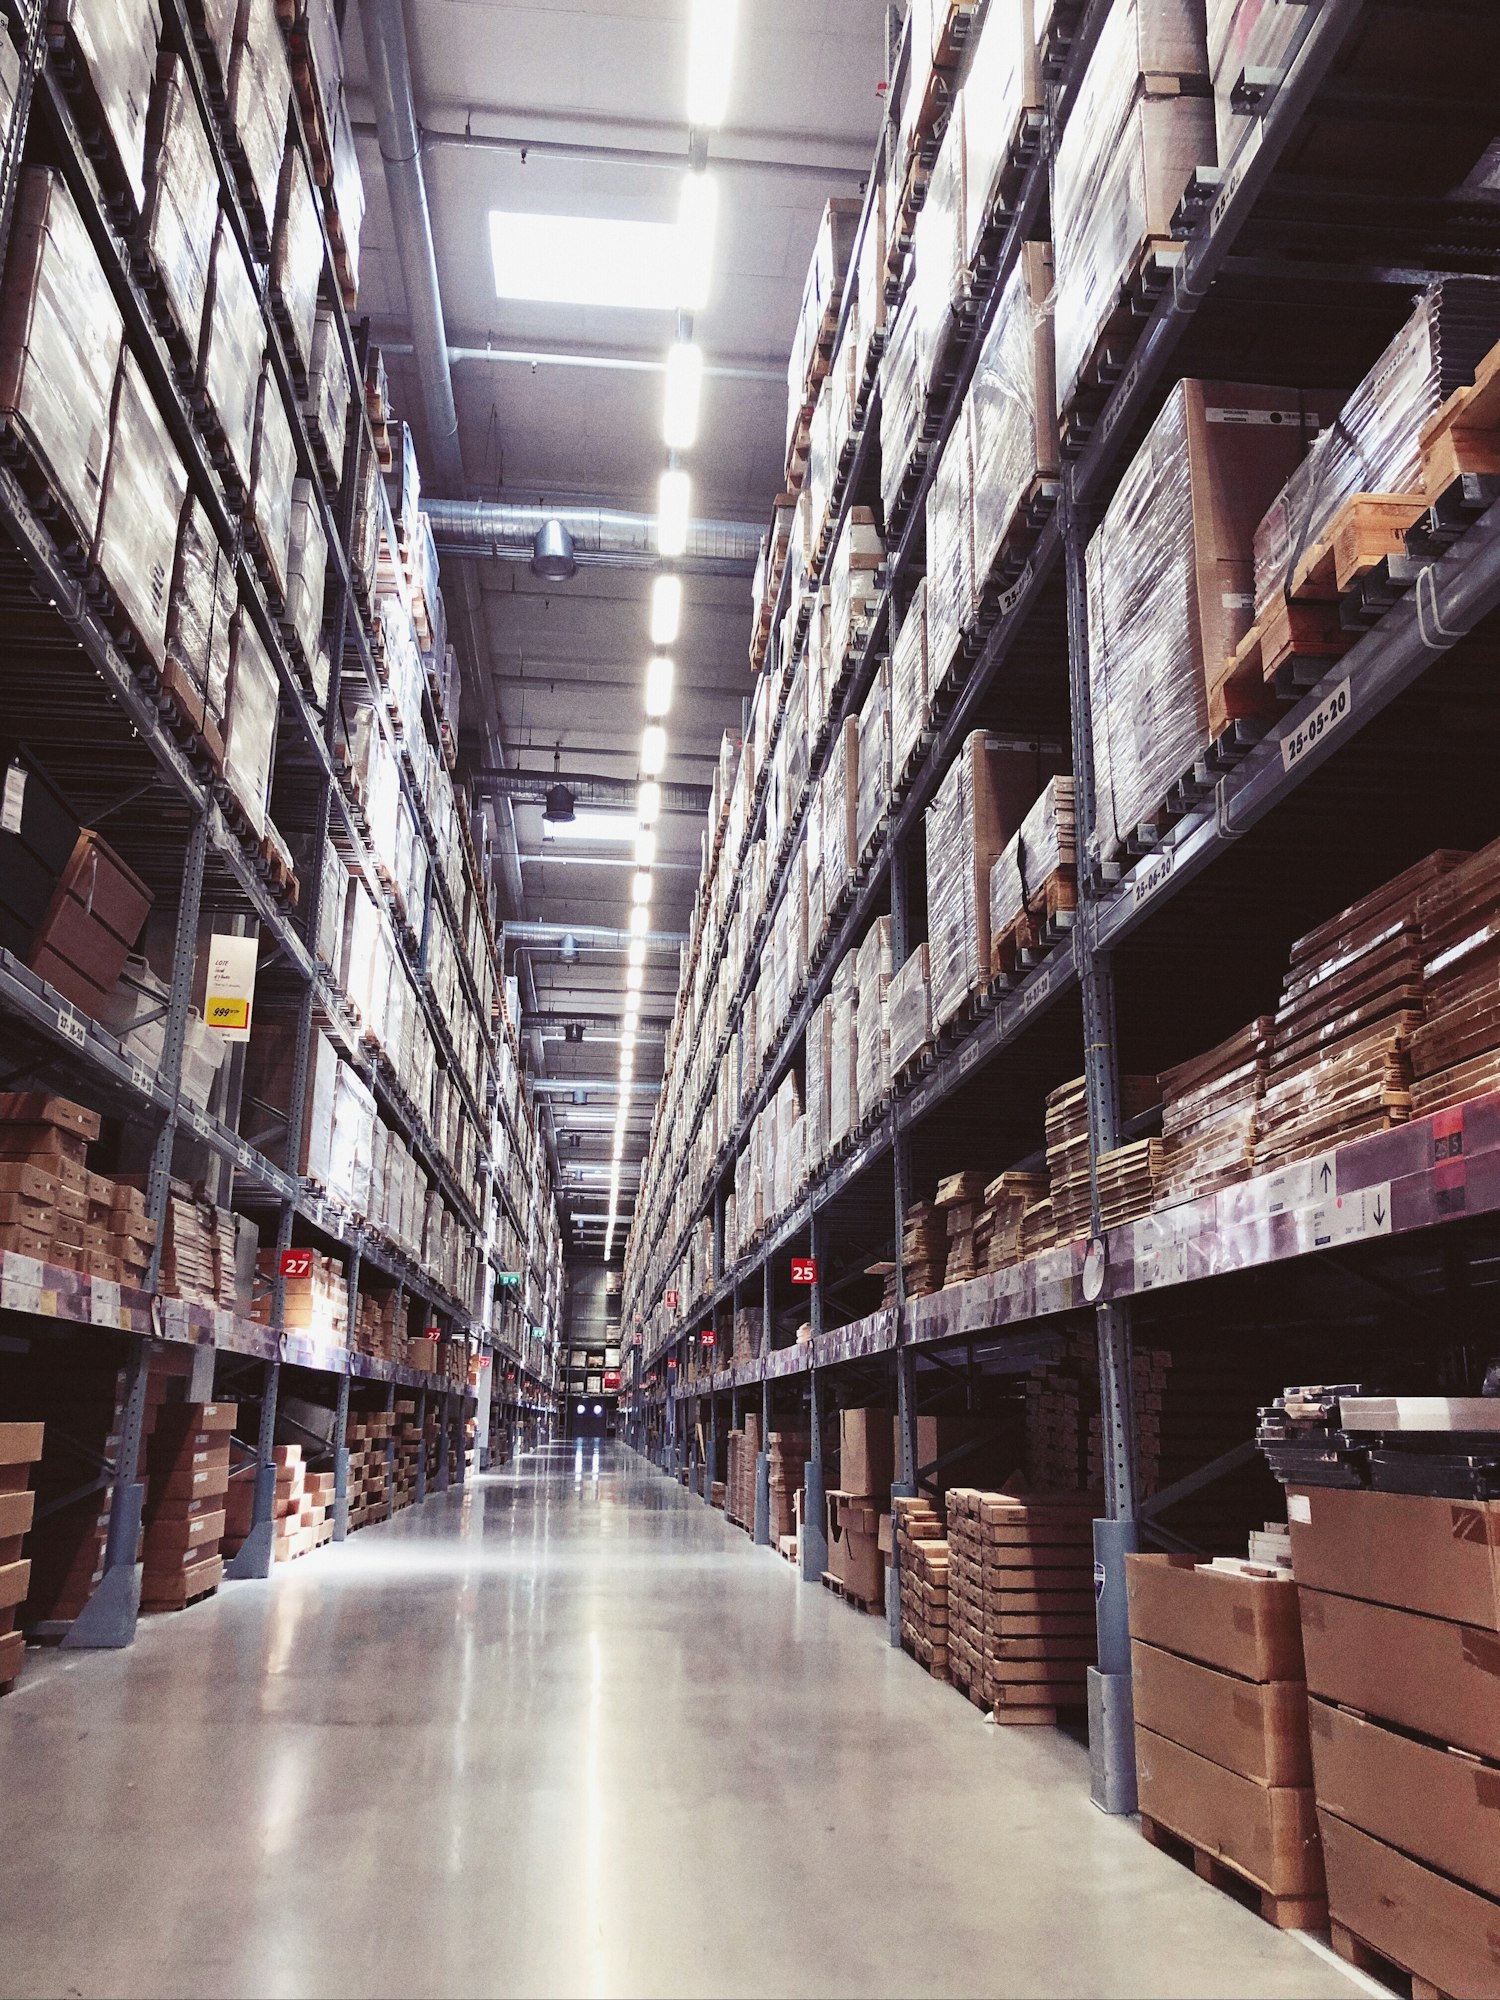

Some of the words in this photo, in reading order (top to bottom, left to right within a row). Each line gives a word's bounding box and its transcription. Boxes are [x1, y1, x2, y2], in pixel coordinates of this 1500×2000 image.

[1288, 691, 1346, 761] 25-05-20
[1136, 857, 1171, 901] 25-06-20
[213, 1007, 230, 1017] 999
[285, 1259, 309, 1274] 27
[793, 1266, 814, 1281] 25
[427, 1332, 441, 1341] 27
[702, 1335, 714, 1344] 25
